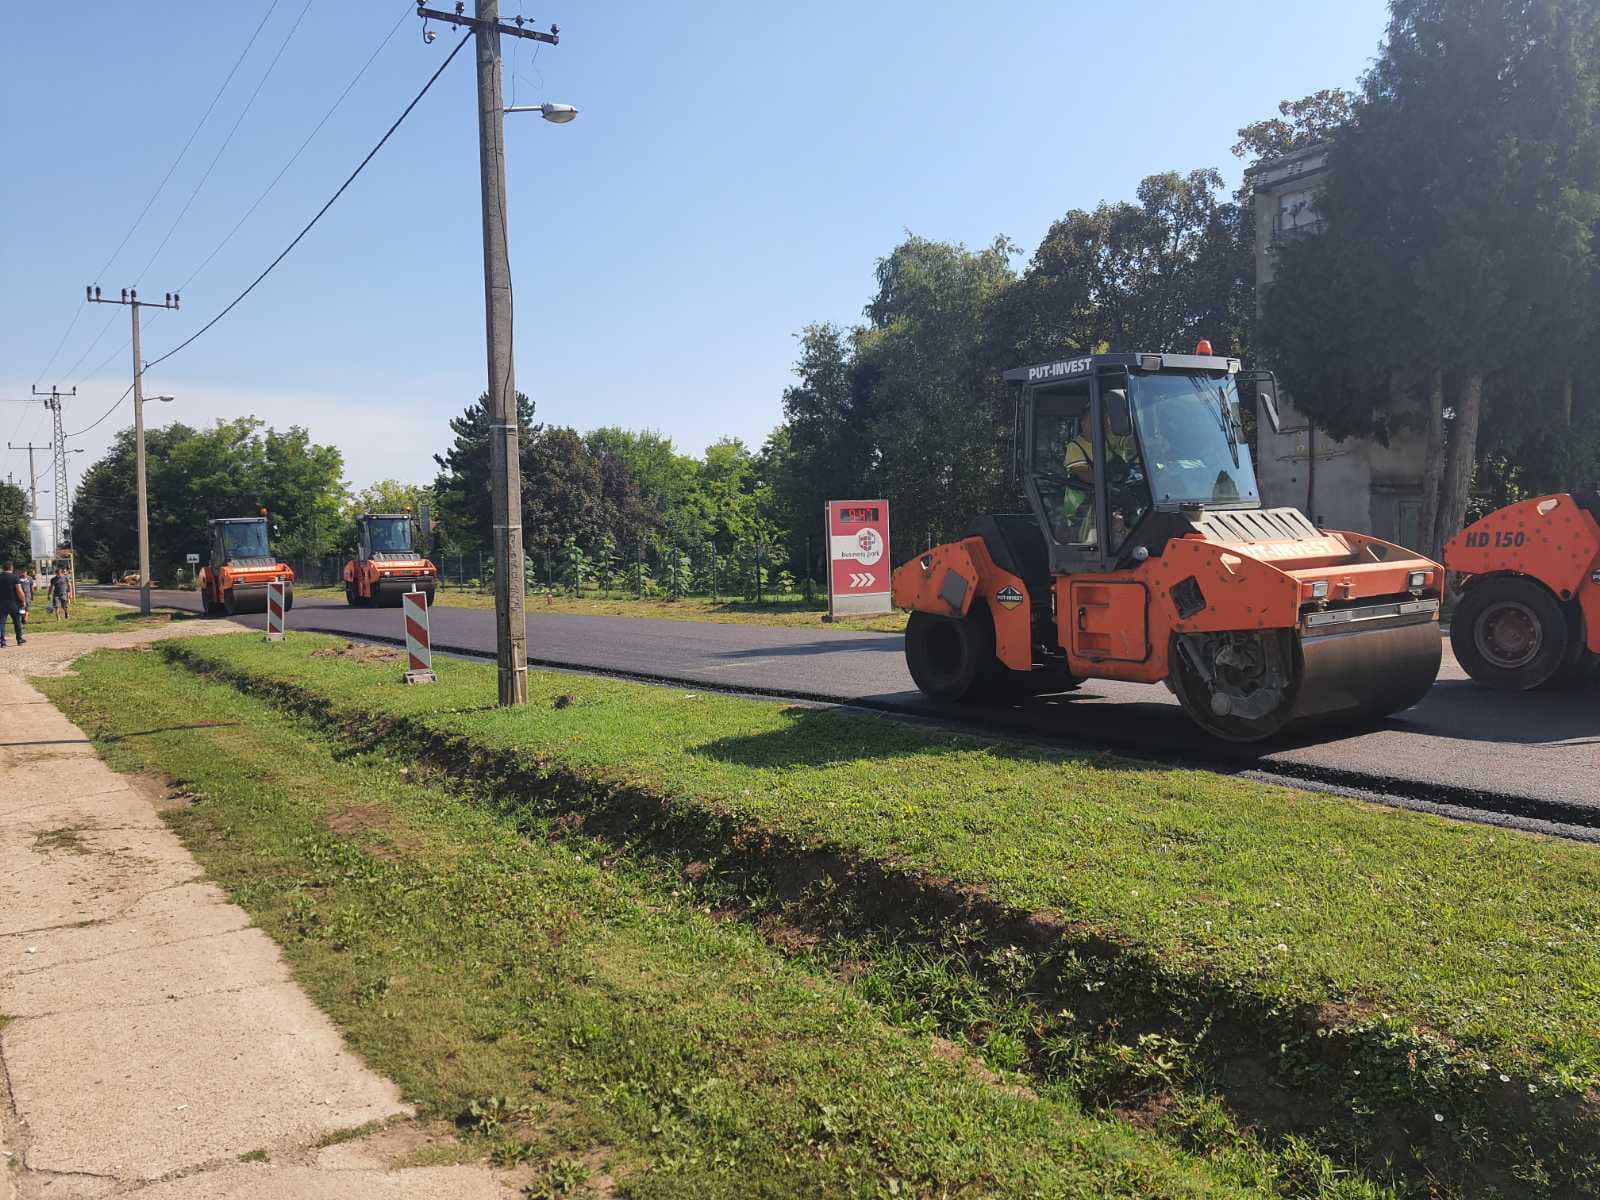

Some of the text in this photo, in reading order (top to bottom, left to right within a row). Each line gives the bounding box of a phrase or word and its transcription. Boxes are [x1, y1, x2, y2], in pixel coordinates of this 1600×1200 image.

[1028, 358, 1092, 380] PUT-INVEST
[1465, 531, 1525, 548] HD 150
